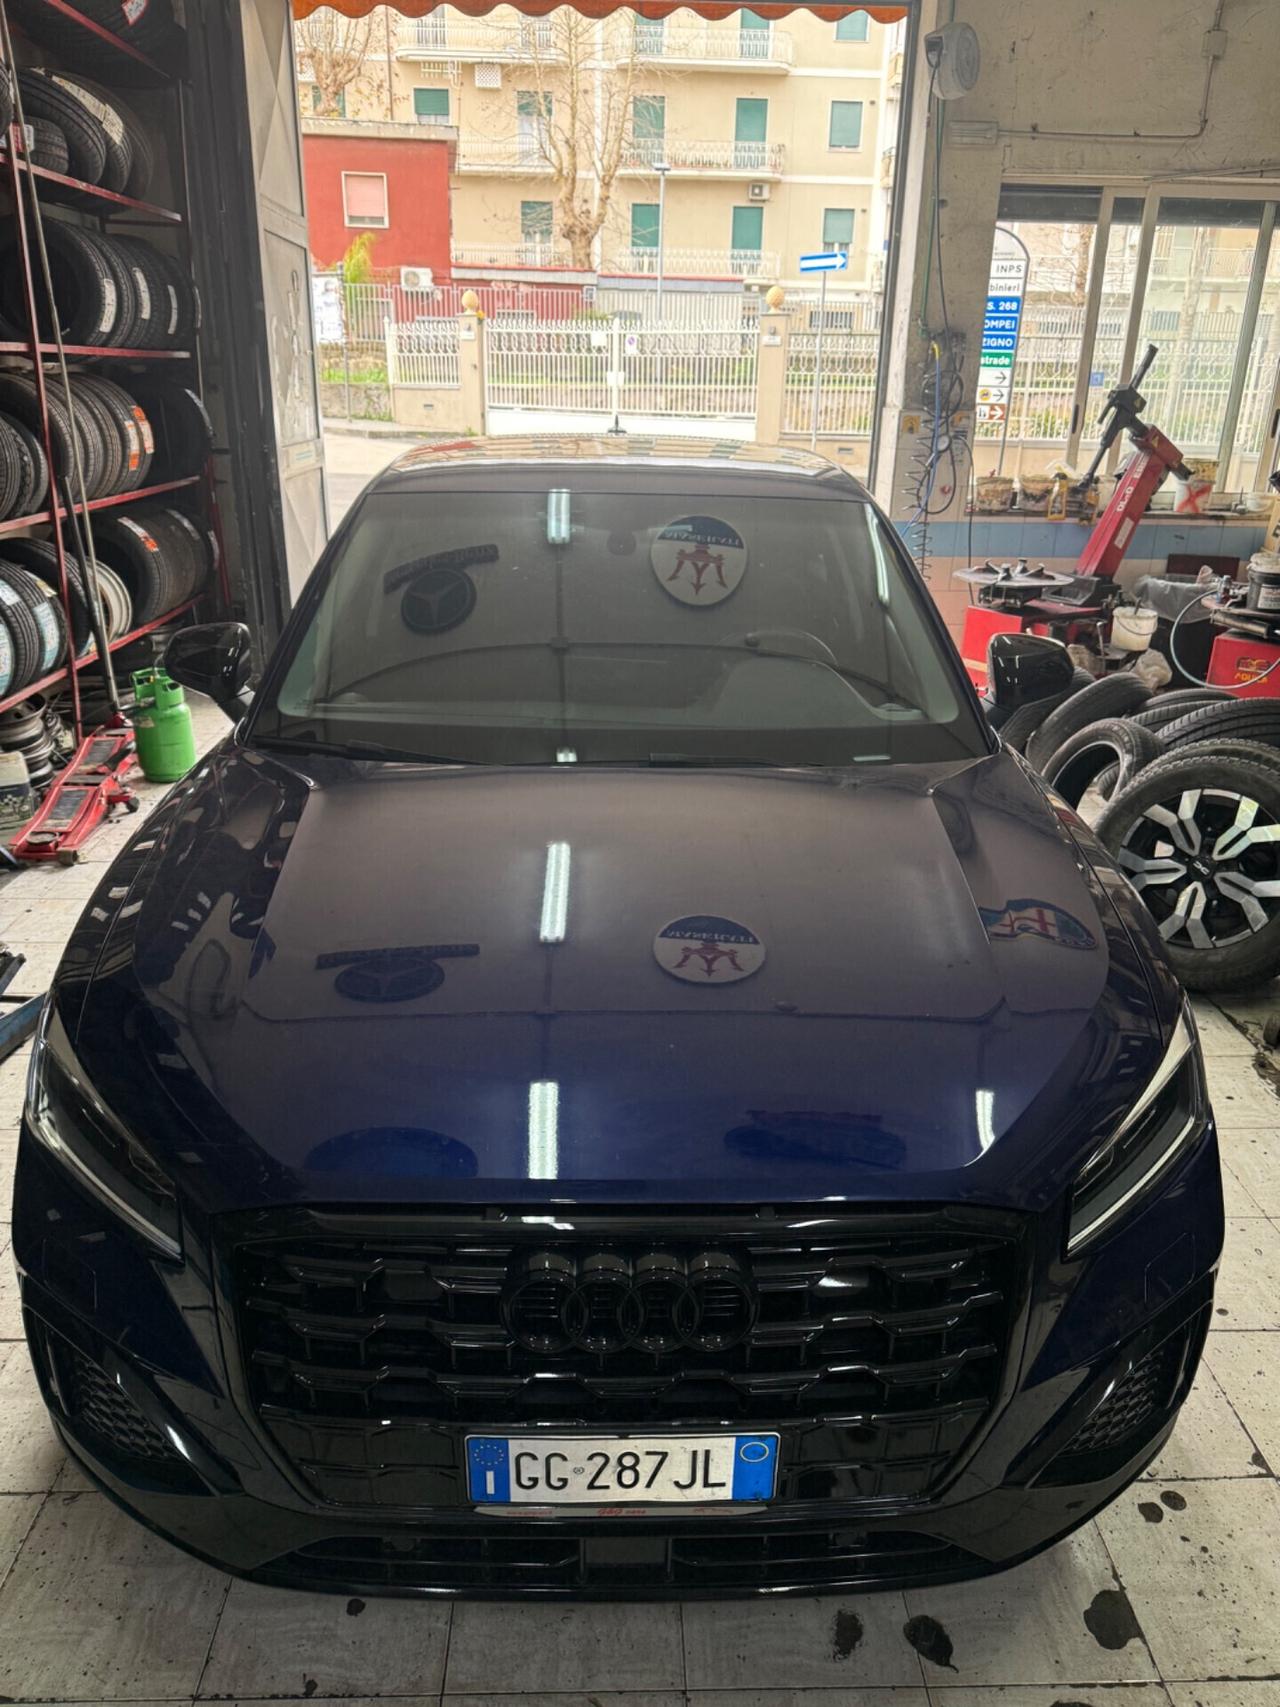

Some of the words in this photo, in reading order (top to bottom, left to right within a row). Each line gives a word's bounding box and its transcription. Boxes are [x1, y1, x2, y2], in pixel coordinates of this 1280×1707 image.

[996, 264, 1022, 273] INPS
[998, 302, 1018, 310] 268
[514, 1451, 569, 1490] GG
